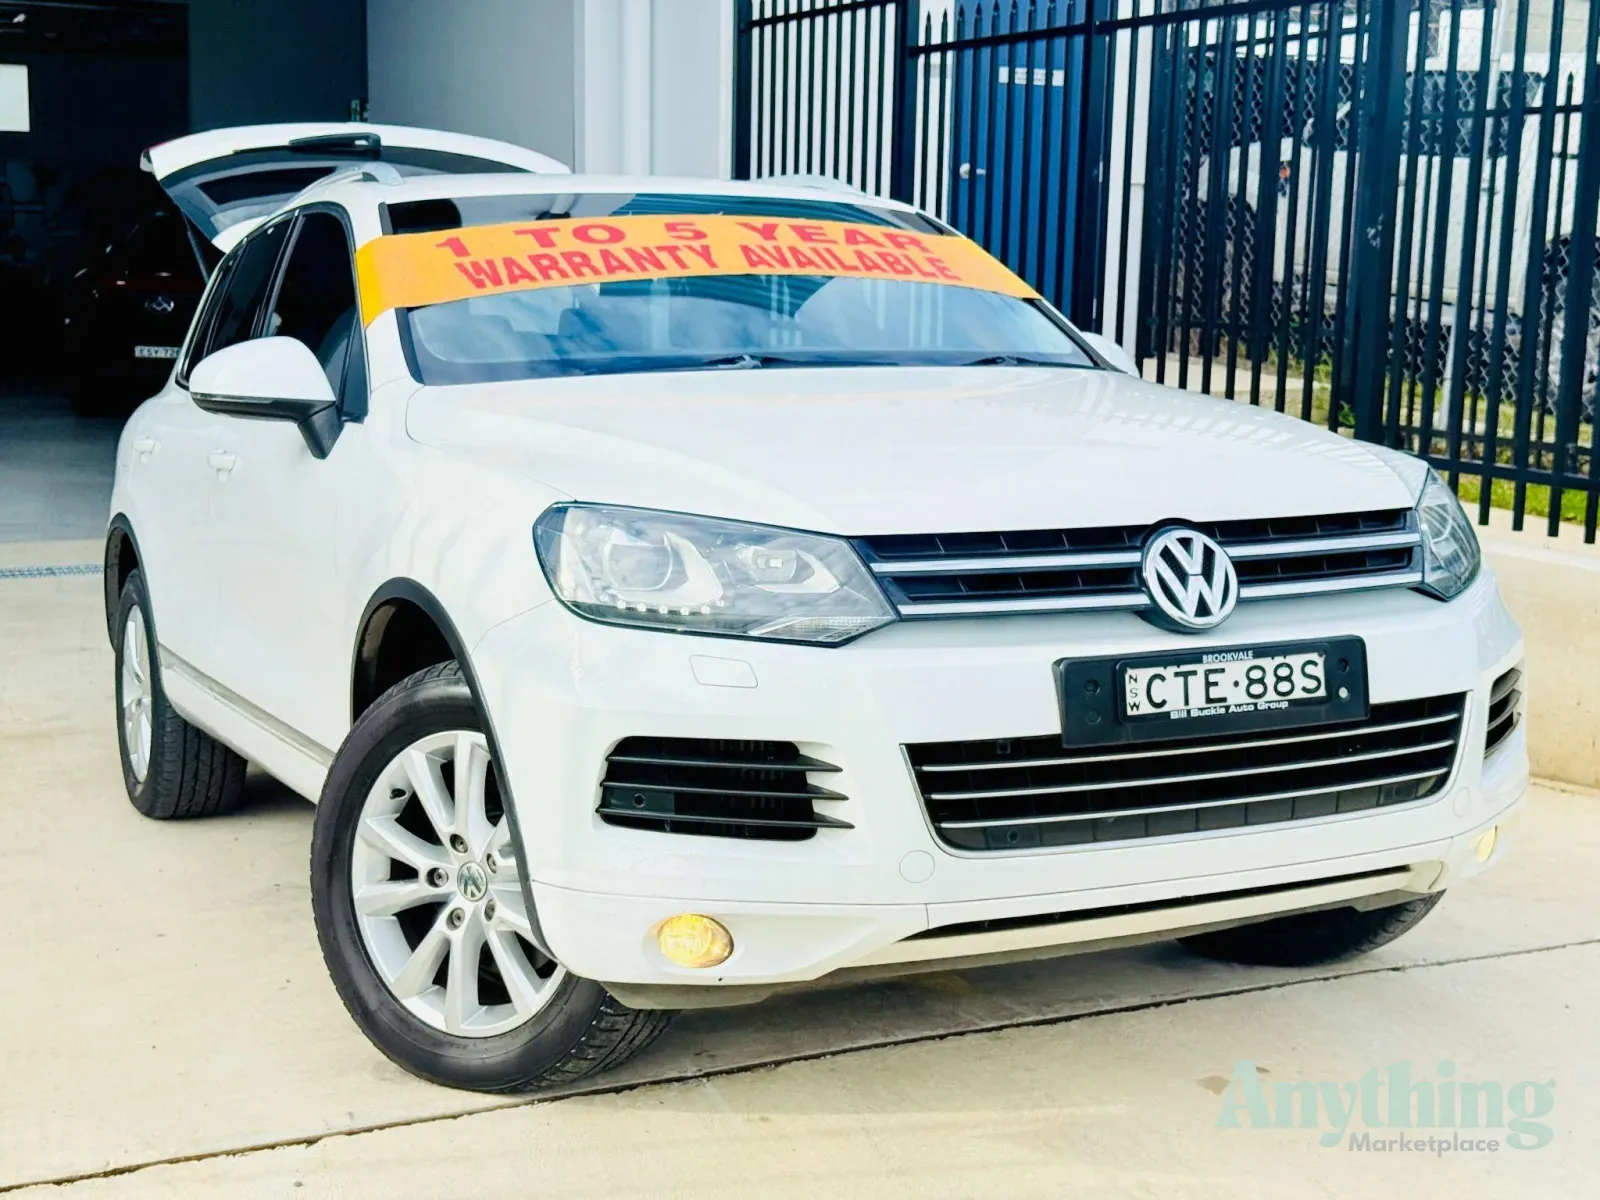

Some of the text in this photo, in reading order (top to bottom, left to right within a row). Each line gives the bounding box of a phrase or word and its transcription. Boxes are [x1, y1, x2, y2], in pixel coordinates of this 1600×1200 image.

[435, 222, 936, 258] 1 TO 5 YEAR
[454, 244, 962, 289] WARRANTY AVAILABLE
[1202, 651, 1254, 664] BROOKVALE
[1128, 674, 1140, 712] NSW
[1170, 710, 1187, 720] Bill
[1228, 702, 1255, 714] Auto
[1257, 700, 1289, 712] Group
